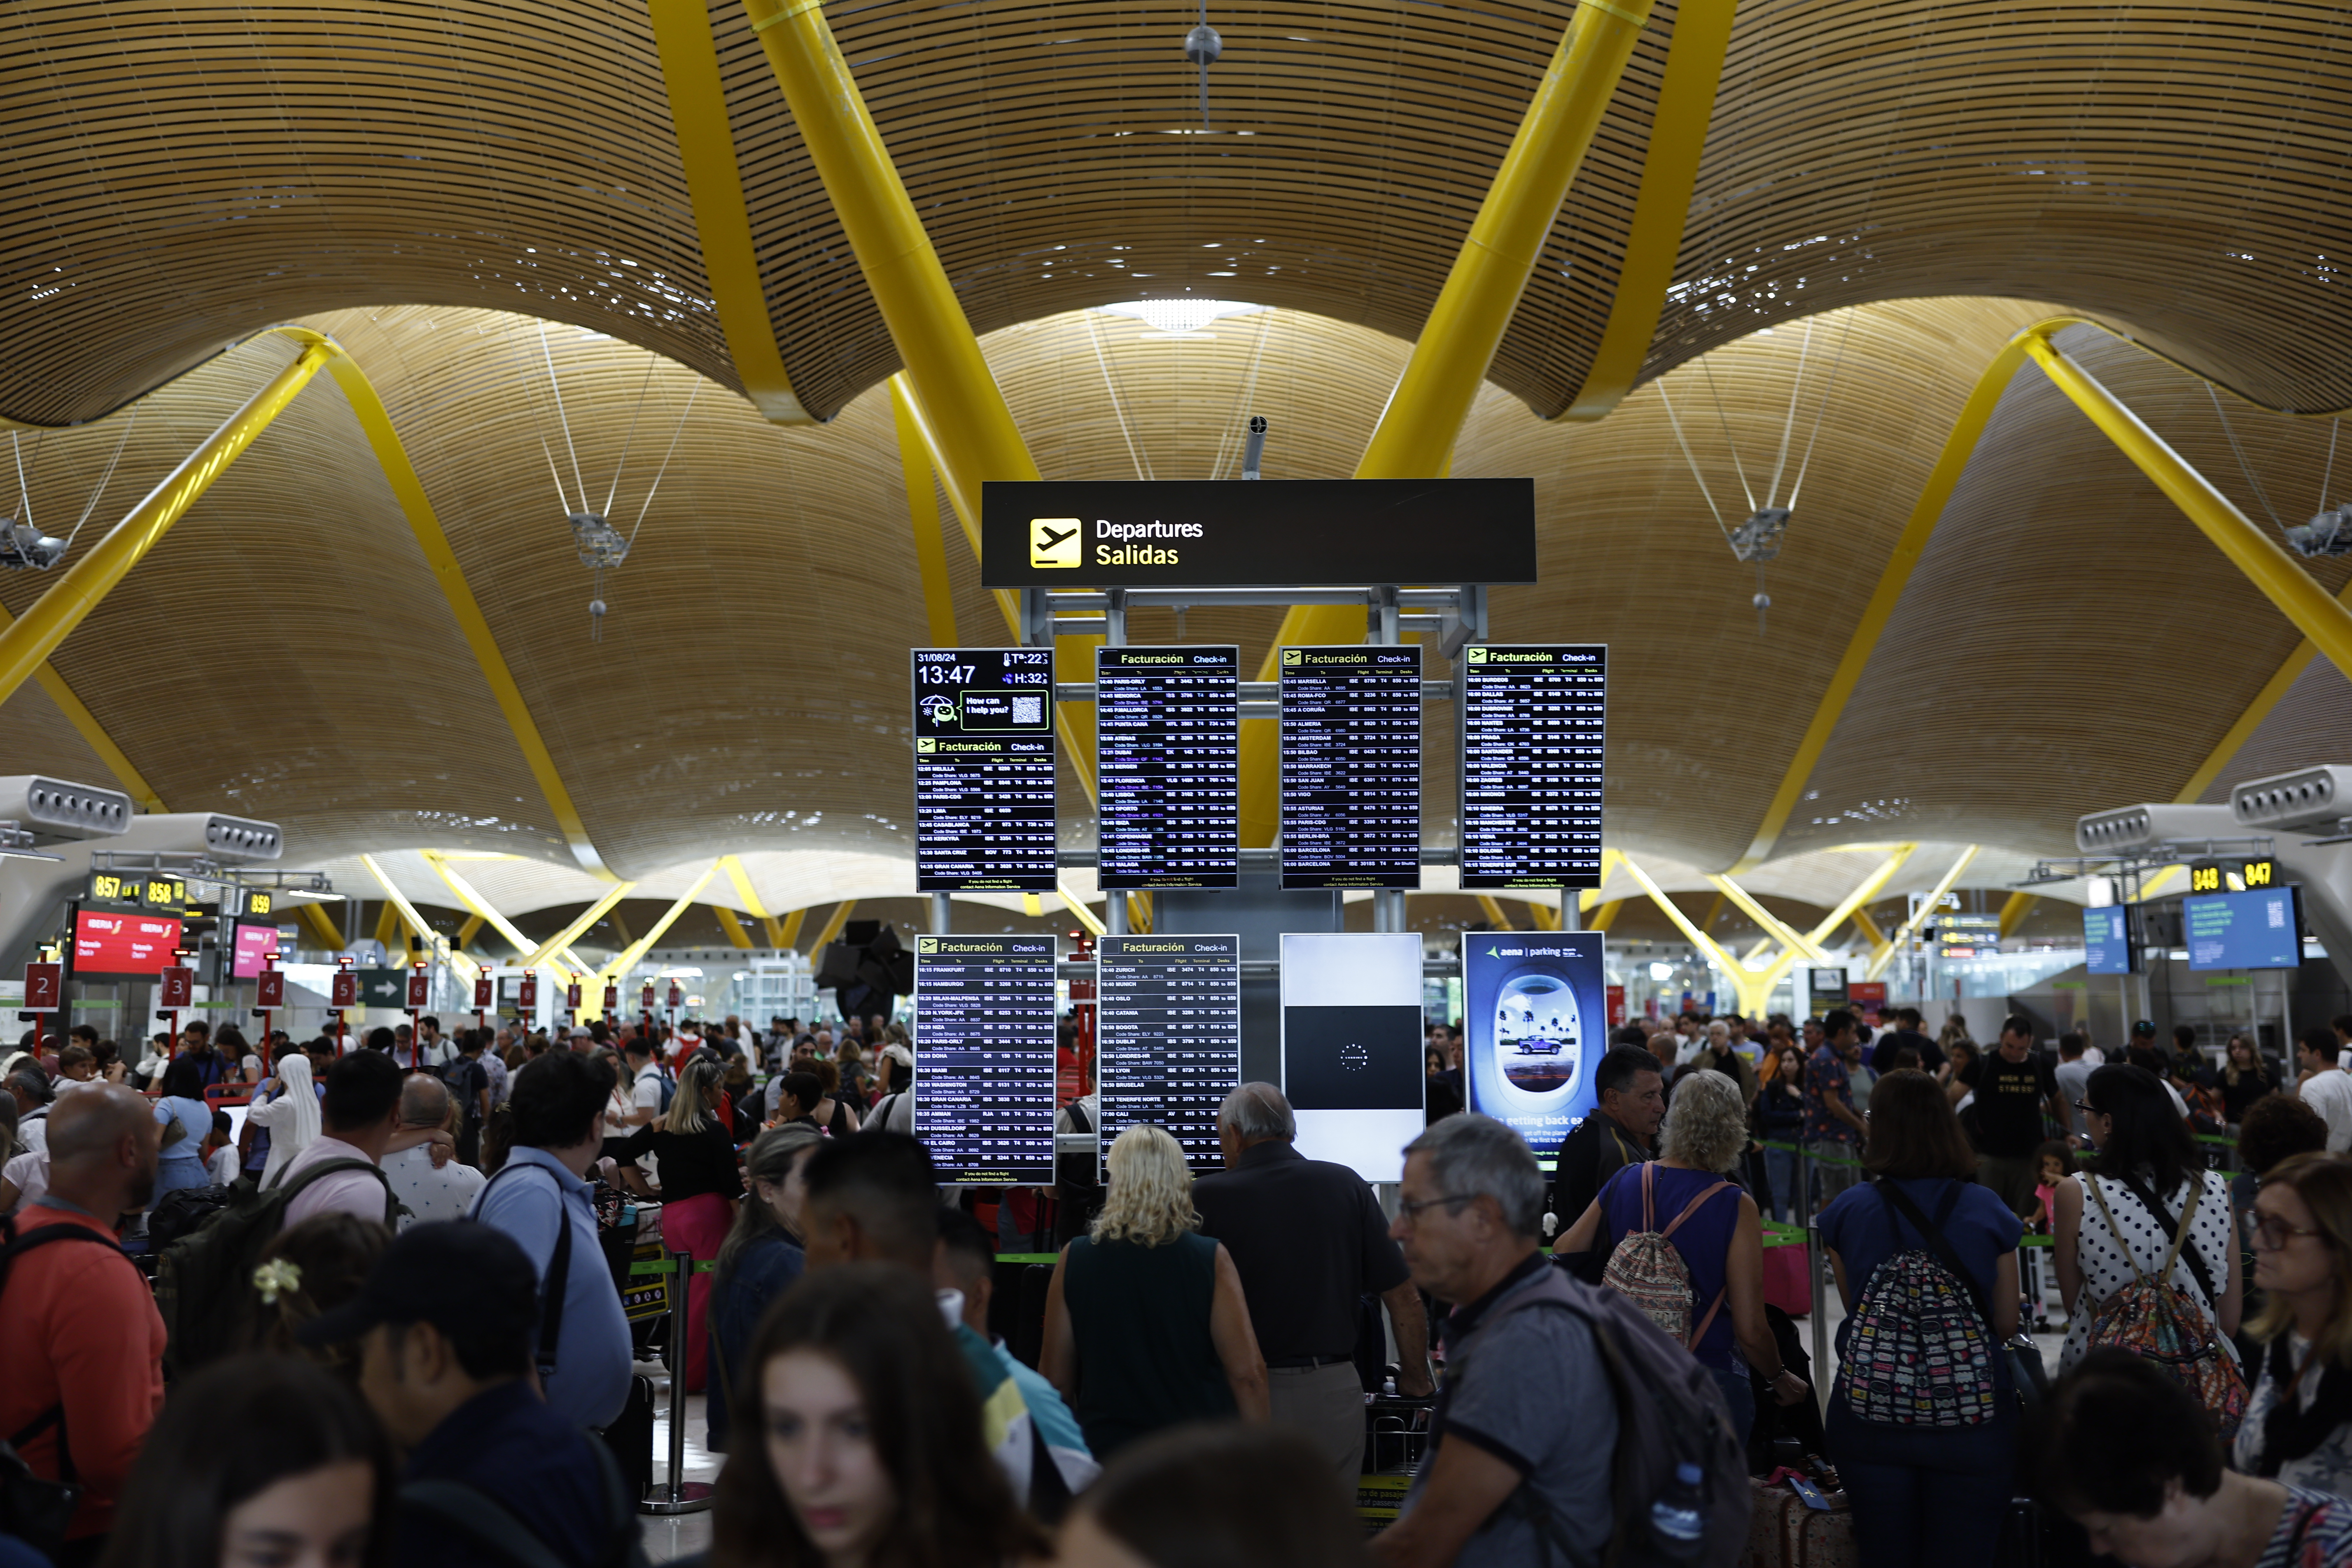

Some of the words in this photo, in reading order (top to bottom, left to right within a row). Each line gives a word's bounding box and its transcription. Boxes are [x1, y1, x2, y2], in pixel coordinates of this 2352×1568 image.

[1097, 520, 1203, 542] Departures
[1097, 545, 1178, 565] Salidas
[918, 653, 956, 662] 31/08/24
[1122, 654, 1183, 663] Facturación
[1306, 654, 1367, 663] Facturación
[1491, 652, 1552, 661] Facturación
[919, 666, 975, 684] 13:47
[940, 742, 1001, 751] Facturación
[2193, 868, 2219, 891] 848
[2245, 863, 2271, 885] 847
[96, 875, 120, 898] 857
[148, 882, 171, 903] 858
[251, 894, 270, 913] 859
[88, 919, 113, 929] IBERIA
[140, 923, 163, 933] IBERIA
[941, 943, 1002, 951] Facturación
[1123, 943, 1184, 952] Facturación
[1530, 947, 1561, 957] parking
[37, 978, 48, 994] 2
[172, 980, 182, 994] 3
[265, 982, 275, 995] 4
[340, 984, 348, 997] 5
[415, 986, 422, 997] 6
[481, 987, 488, 999] 7
[1506, 1116, 1543, 1127] getting
[1545, 1116, 1568, 1125] back
